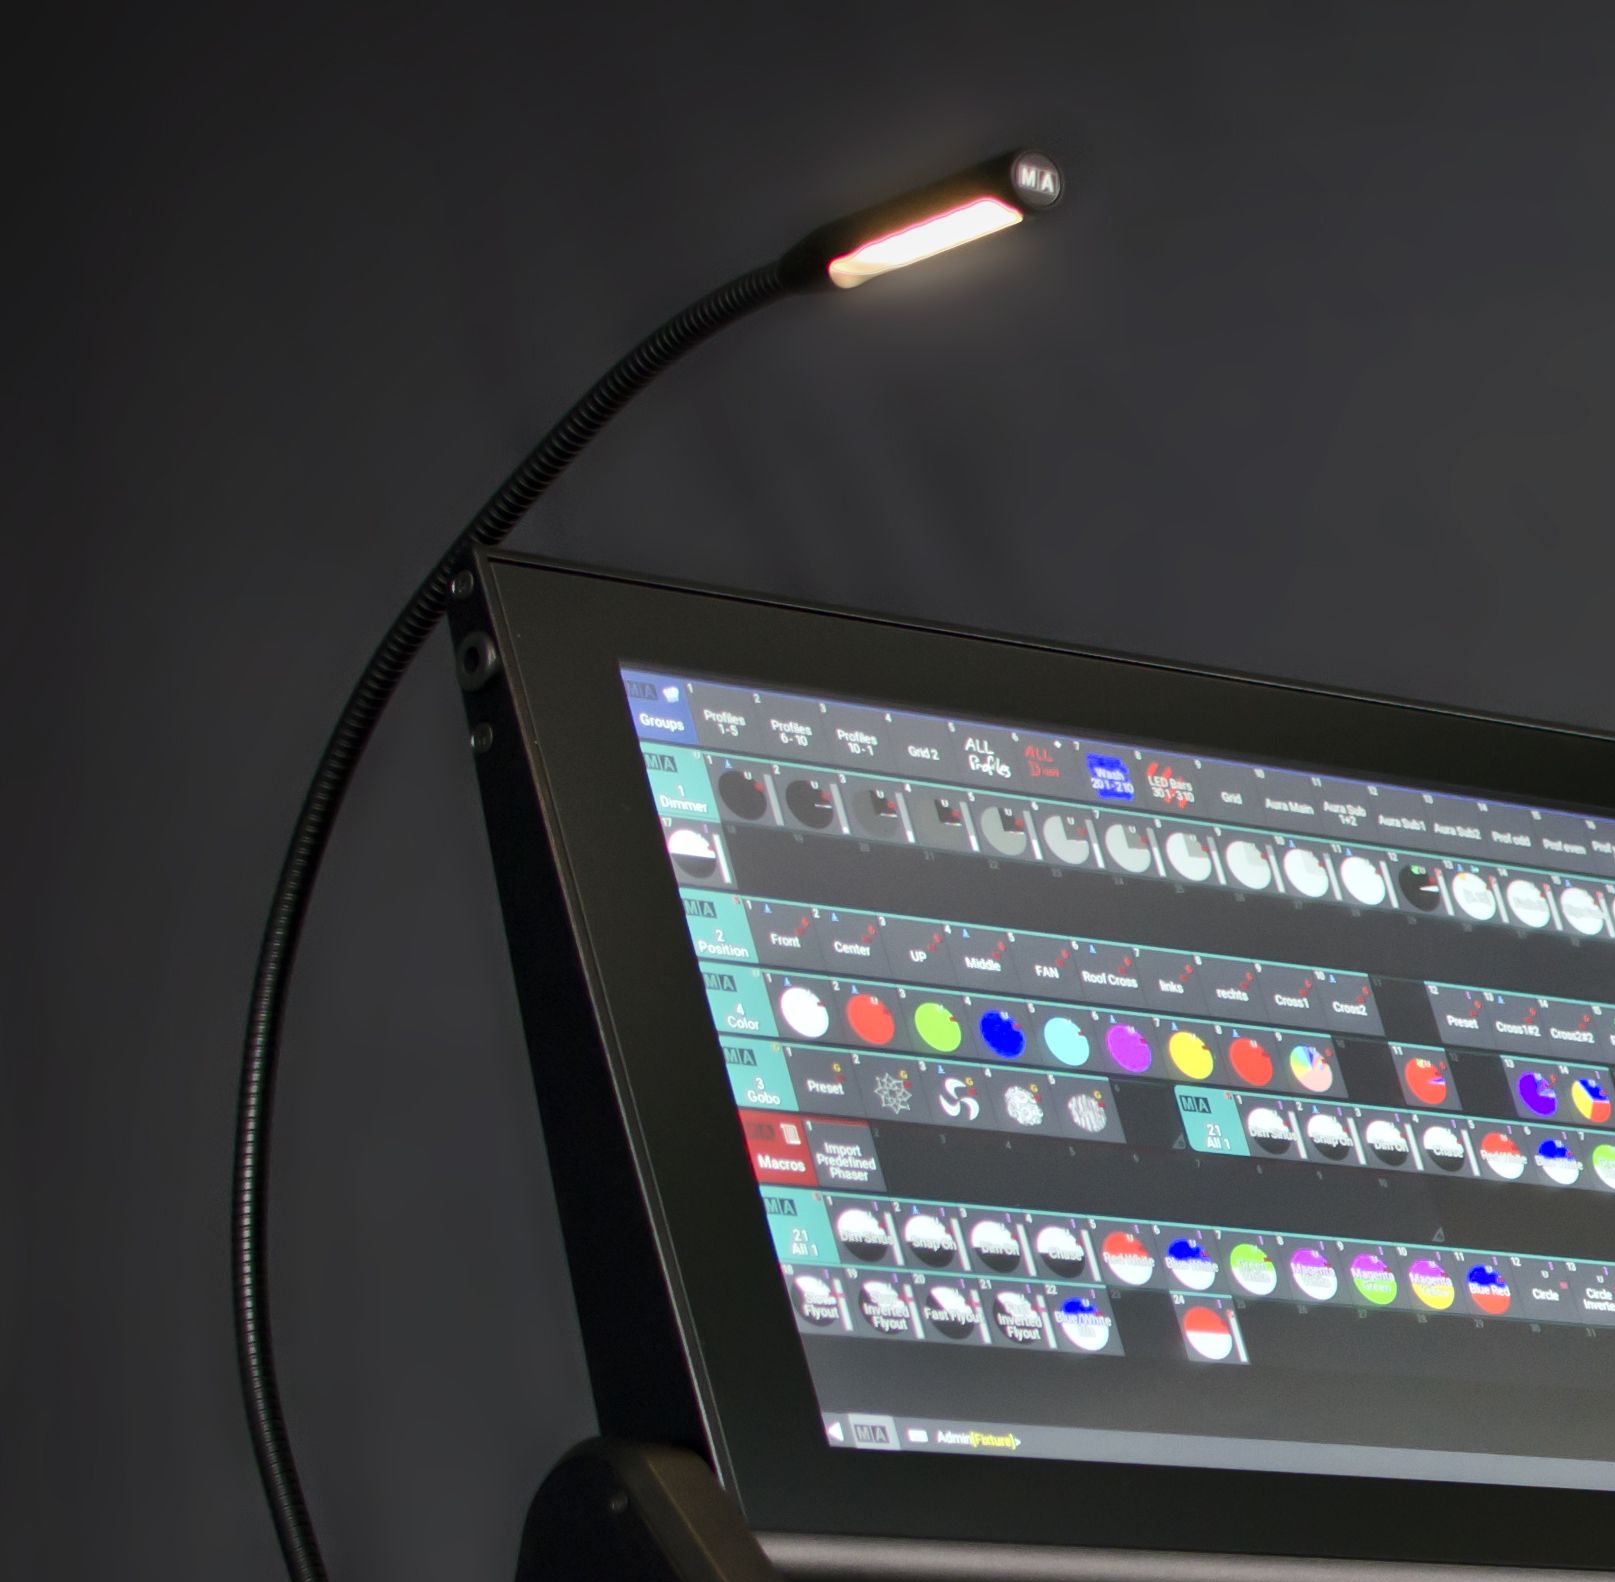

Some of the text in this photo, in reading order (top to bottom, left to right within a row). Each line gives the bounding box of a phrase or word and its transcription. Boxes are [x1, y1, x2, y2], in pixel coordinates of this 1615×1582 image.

[640, 713, 684, 731] Groups
[704, 709, 745, 726] Profiles
[771, 719, 812, 736] Profiles
[837, 729, 878, 746] Profiles
[908, 746, 940, 760] Grid 2
[965, 738, 994, 755] ALL
[968, 754, 1011, 778] Profiles
[1095, 767, 1124, 781] Wash
[1148, 776, 1192, 791] LED Bars
[660, 795, 707, 813] Dimmer
[1221, 791, 1242, 805] Grid
[1265, 798, 1288, 811] Aura
[1323, 801, 1345, 814] Aura
[715, 930, 724, 942] 2
[770, 933, 801, 948] Front
[697, 940, 749, 958] Position
[834, 941, 870, 956] Center
[910, 950, 927, 962] UP
[965, 956, 1001, 972] Middle
[1035, 964, 1059, 979] FAN
[1082, 970, 1138, 988] Roof Cross
[1216, 988, 1249, 1001] rechts
[736, 1004, 745, 1015] 4
[727, 1015, 759, 1031] Color
[1446, 1015, 1479, 1029] Preset
[756, 1077, 764, 1089] 3
[806, 1079, 845, 1095] Preset
[747, 1090, 780, 1105] Gobo
[824, 1142, 862, 1157] Import
[758, 1154, 806, 1173] Macros
[817, 1155, 876, 1170] Predefined
[830, 1167, 868, 1182] Phaser
[792, 1229, 808, 1242] 21
[792, 1242, 818, 1257] All 1
[1350, 1267, 1394, 1282] Magenta
[1409, 1272, 1452, 1287] Magenta
[1469, 1283, 1491, 1295] Blue
[1532, 1288, 1559, 1301] Circle
[1586, 1288, 1613, 1300] Circle
[803, 1305, 839, 1320] Flyout
[863, 1302, 910, 1319] Inverted
[872, 1316, 907, 1332] Flyout
[1006, 1325, 1041, 1341] Flyout
